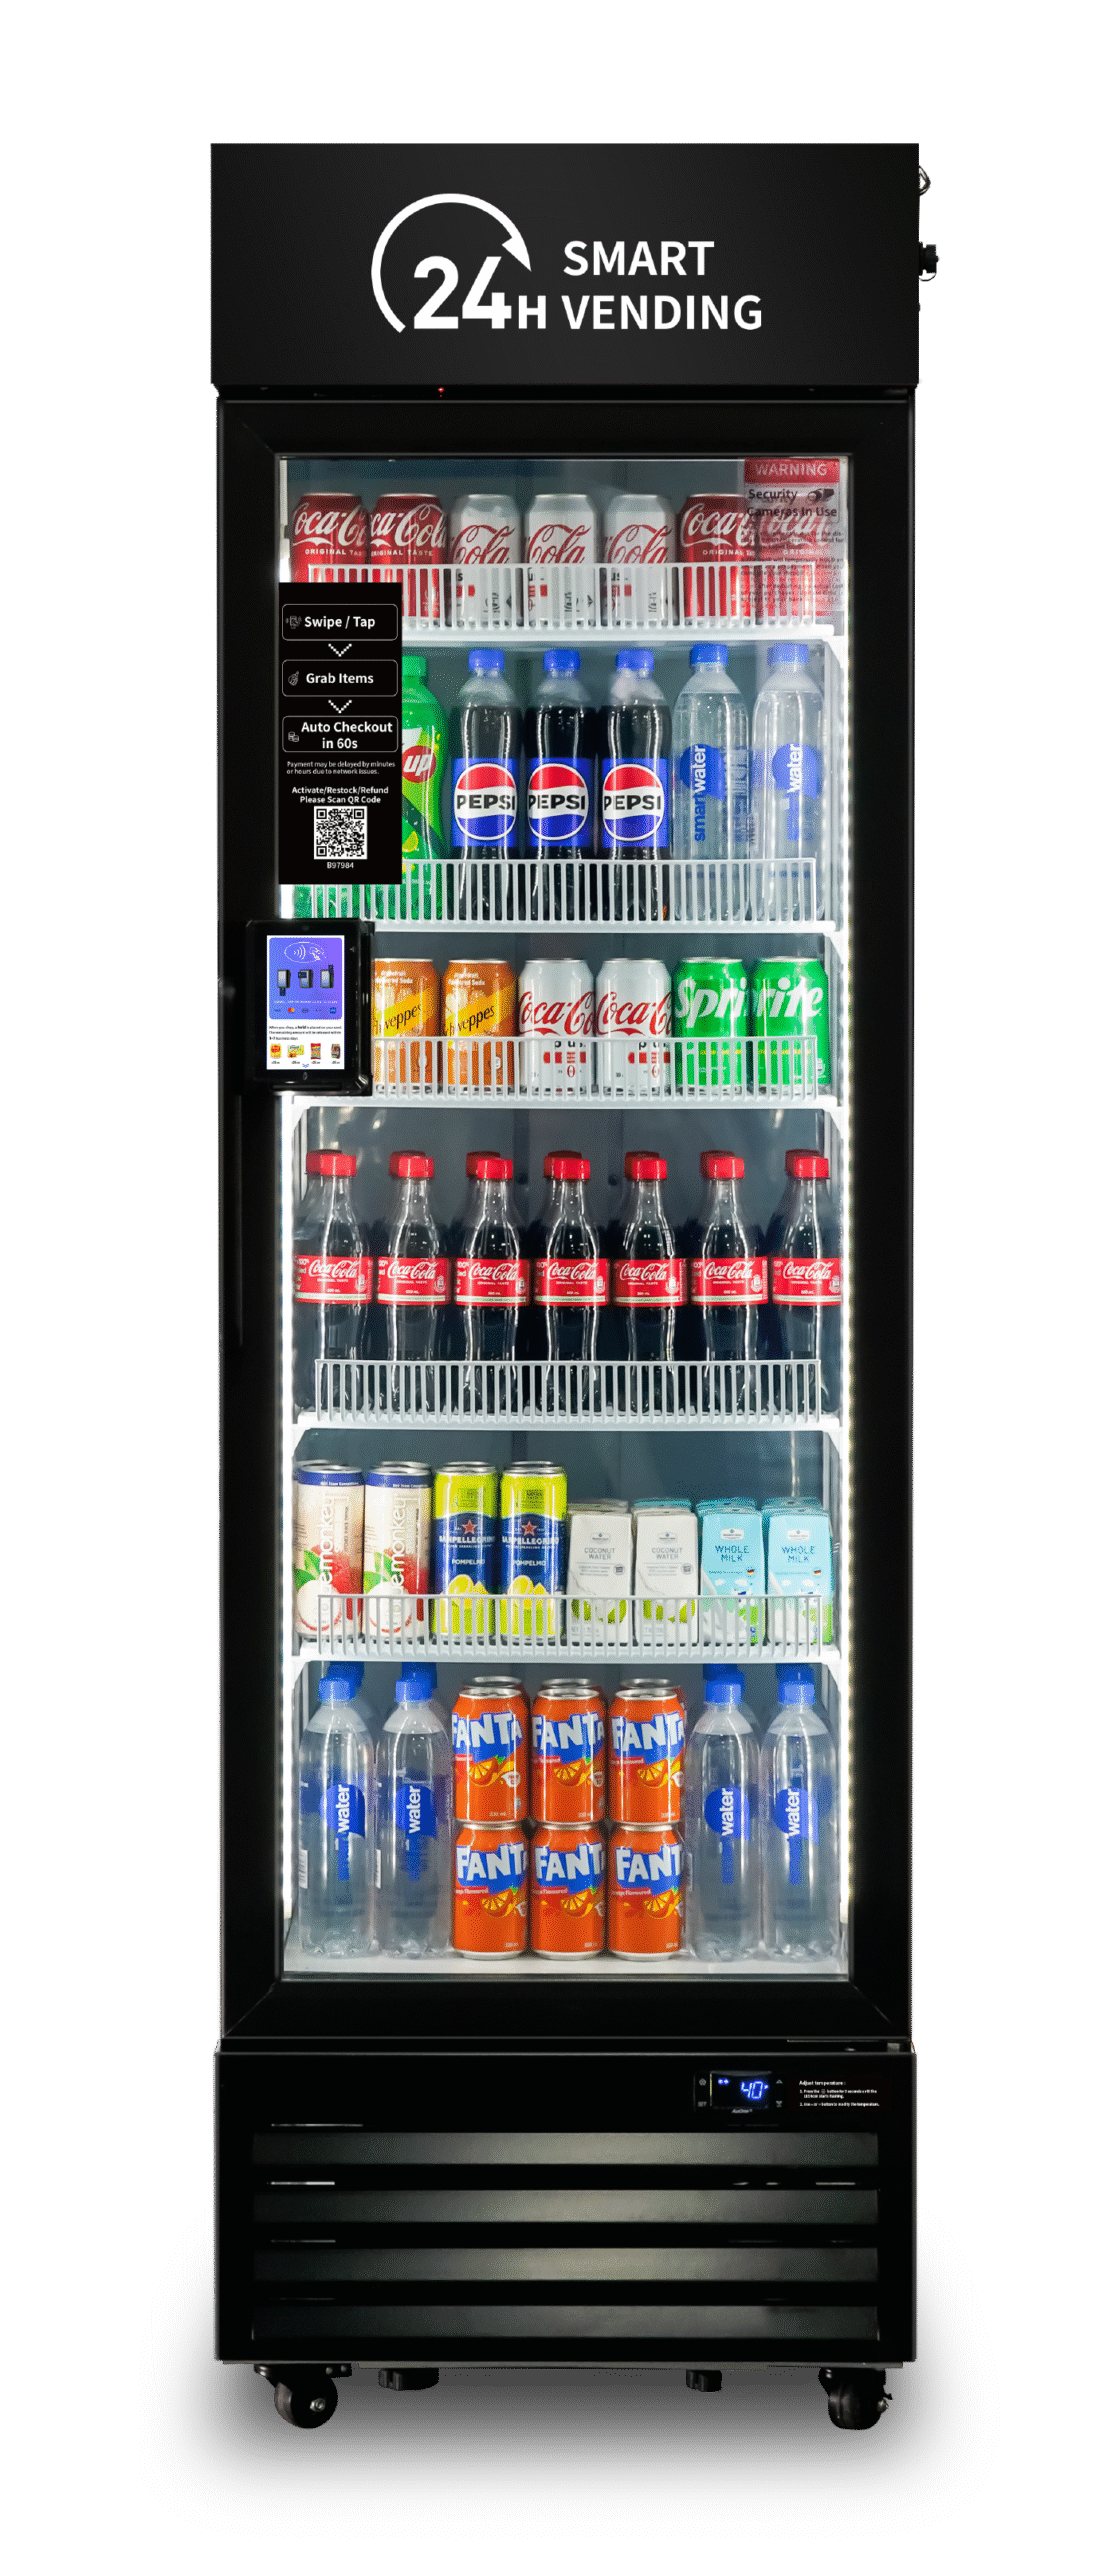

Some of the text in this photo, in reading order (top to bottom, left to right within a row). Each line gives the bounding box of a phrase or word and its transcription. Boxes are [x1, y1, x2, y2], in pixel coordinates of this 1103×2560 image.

[563, 240, 715, 276] SMART
[414, 255, 547, 329] 24H
[562, 294, 762, 330] VENDING
[755, 463, 828, 476] WARNING
[749, 488, 798, 505] Security
[747, 506, 838, 517] Cameras In Use
[304, 548, 346, 556] ORIGINAL
[304, 615, 376, 629] Swipe / Tap
[306, 672, 374, 684] Grab Items
[301, 721, 393, 733] Auto Checkout
[322, 737, 358, 749] in 60s
[337, 760, 361, 768] delayed
[361, 760, 370, 768] by
[370, 760, 396, 768] minutes
[292, 786, 389, 795] Activate/Restock/Refund
[347, 796, 360, 804] QR
[456, 794, 516, 810] PEPSI
[529, 794, 586, 811] PEPSI
[604, 794, 661, 811] PEPSI
[326, 861, 354, 869] B97984
[309, 1259, 360, 1279] Coca-Cola
[387, 1260, 439, 1280] Coca-Cola
[468, 1262, 520, 1281] Coca-Cola
[547, 1262, 599, 1280] Coca-Cola
[619, 1263, 670, 1281] Coca-Cola
[704, 1261, 755, 1280] Coca-Cola
[783, 1261, 834, 1280] Coca-Cola
[714, 1545, 750, 1554] WHOLE
[720, 1554, 743, 1562] MILK
[781, 1545, 816, 1554] WHOLE
[452, 1712, 523, 1749] FANTA
[532, 1711, 605, 1752] FANTA
[336, 1784, 350, 1833] water
[406, 1785, 421, 1834] water
[719, 1787, 734, 1836] water
[785, 1788, 800, 1837] water
[615, 1842, 682, 1883] FANT
